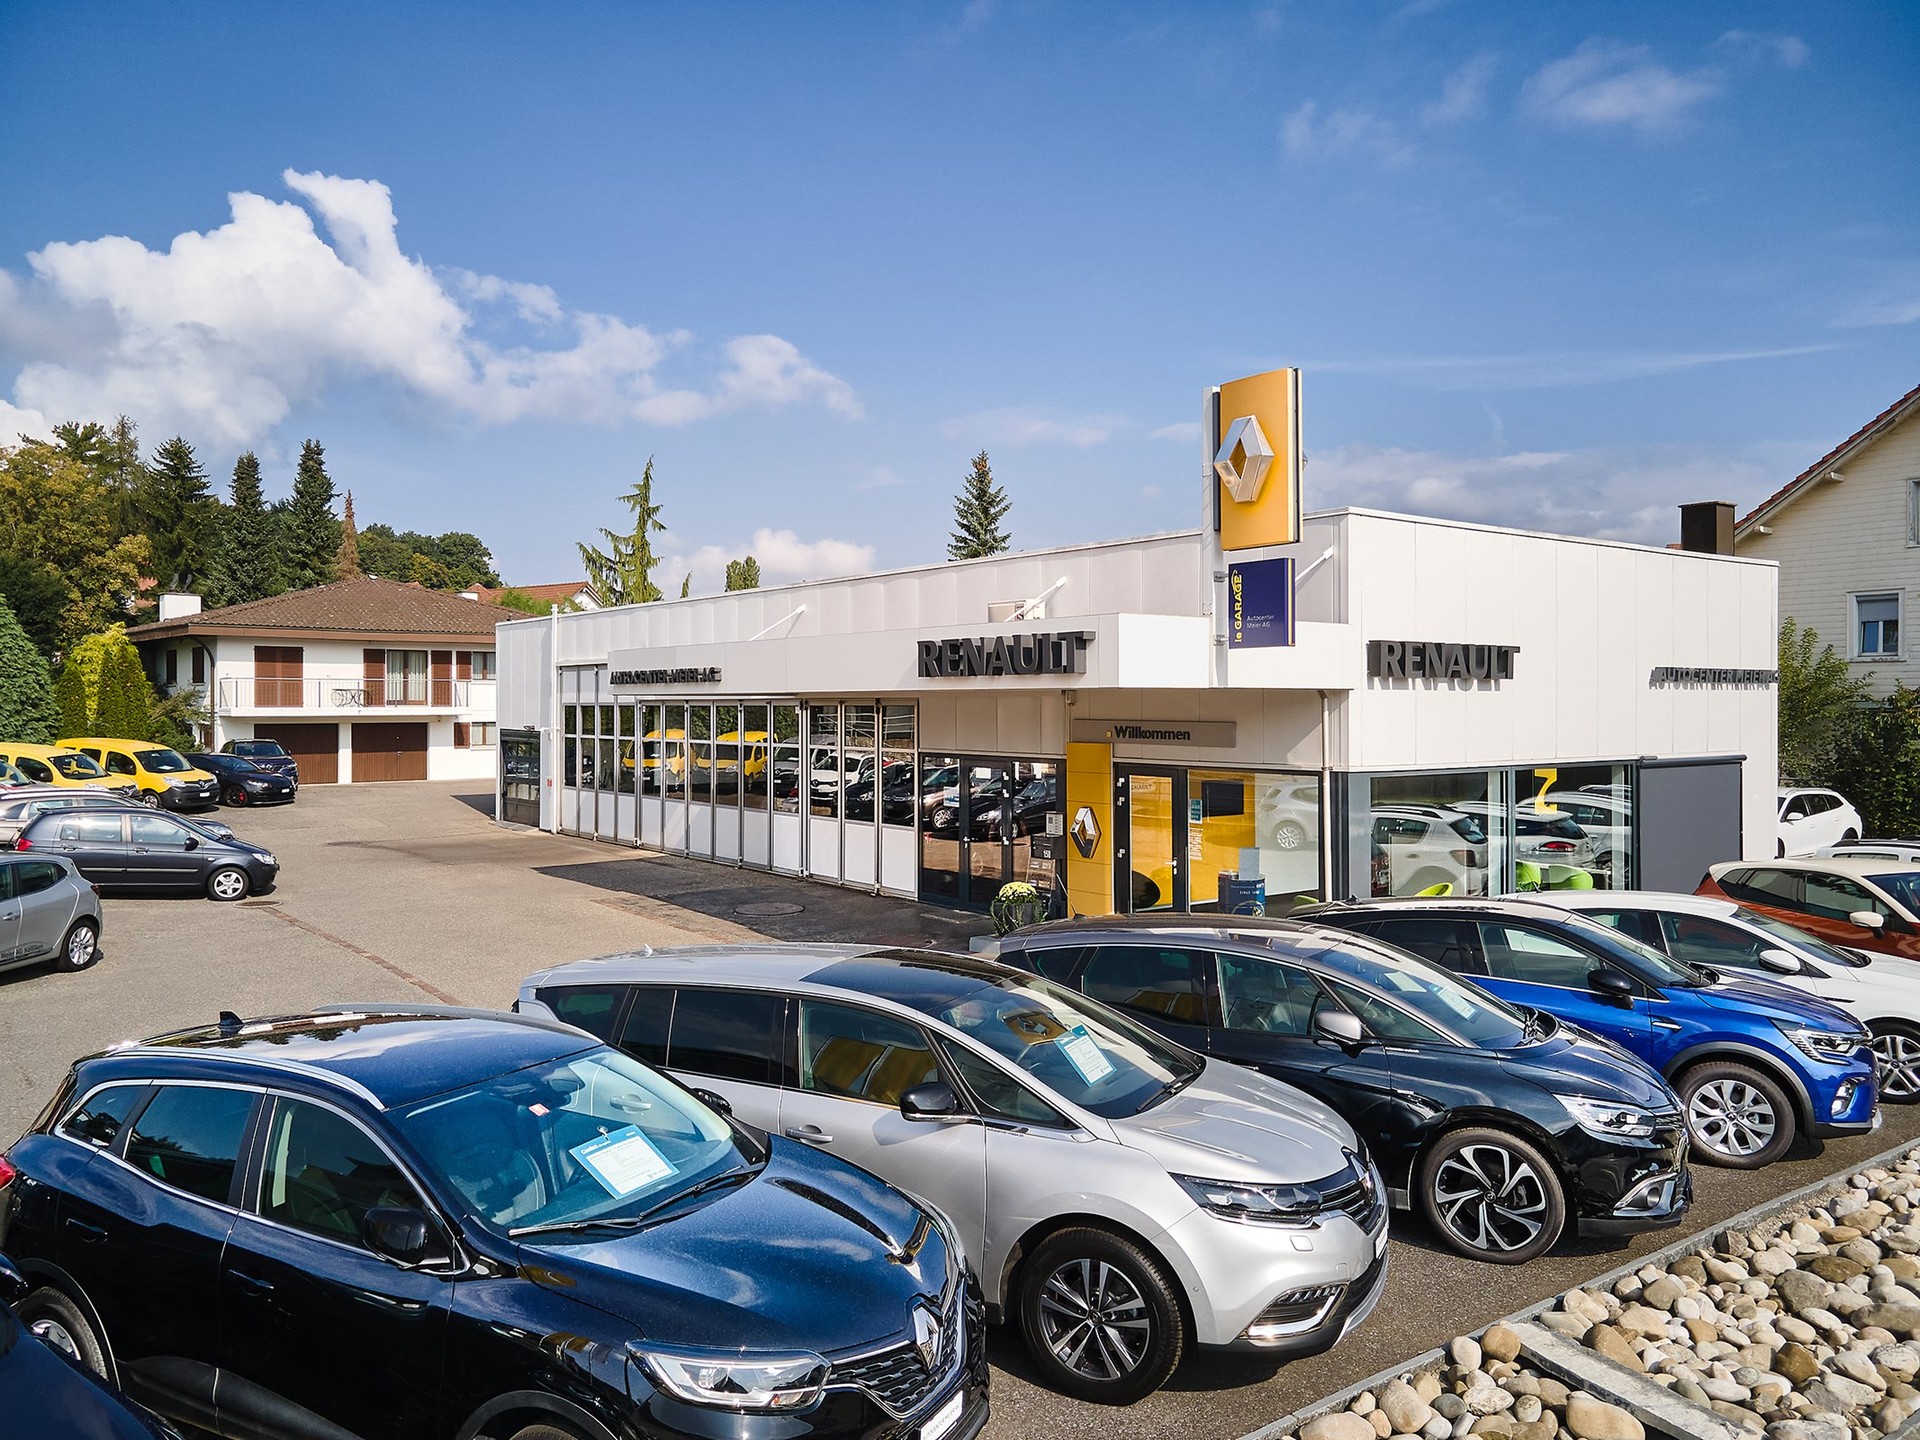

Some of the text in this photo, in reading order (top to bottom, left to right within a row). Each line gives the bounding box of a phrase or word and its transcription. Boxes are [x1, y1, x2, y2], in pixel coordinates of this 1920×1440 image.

[1233, 573, 1243, 643] le GARAGE
[1246, 614, 1275, 622] Autocenter
[917, 631, 1095, 678] RENAULT
[1368, 640, 1521, 680] RENAULT
[671, 667, 701, 683] MEIER
[700, 666, 720, 682] AG
[1656, 667, 1735, 683] AUTOCENTER
[1736, 669, 1764, 684] MEIER
[1114, 725, 1191, 741] Willkommen
